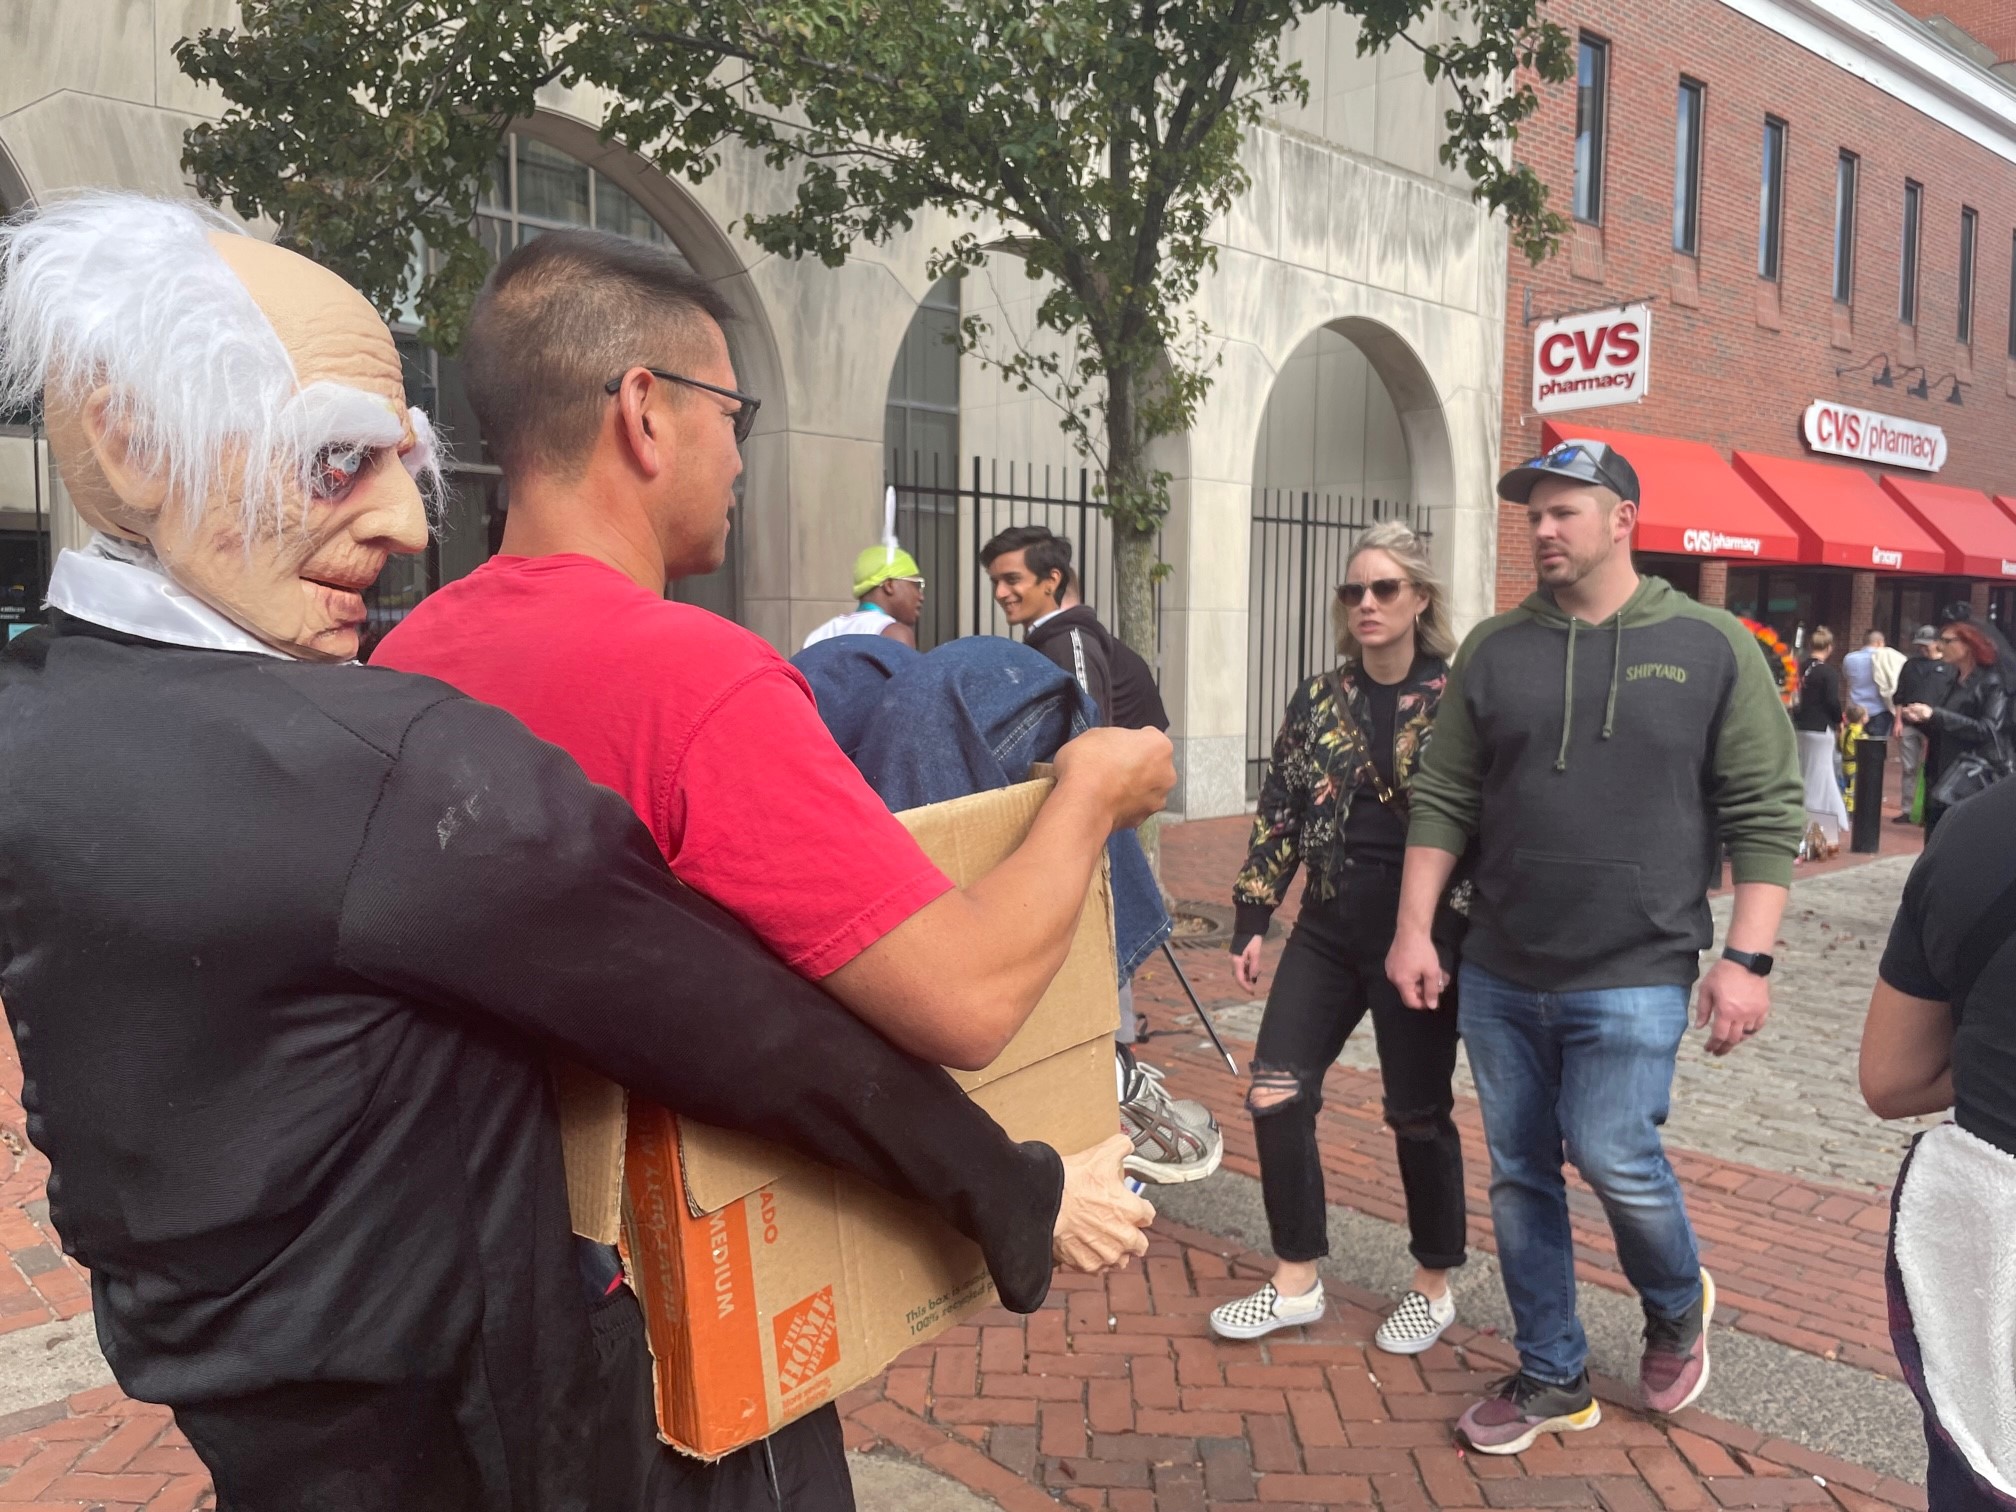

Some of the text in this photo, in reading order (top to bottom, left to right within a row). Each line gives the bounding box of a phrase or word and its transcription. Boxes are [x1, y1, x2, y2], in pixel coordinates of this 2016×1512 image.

[1539, 322, 1640, 376] CVS
[1538, 371, 1636, 400] pharmacy
[1625, 662, 1687, 684] SHIPYARD
[643, 1160, 668, 1231] DUTY
[708, 1209, 736, 1320] MEDIUM
[904, 1305, 928, 1325] This
[927, 1292, 950, 1311] box
[951, 1283, 962, 1297] is
[909, 1310, 940, 1336] 100%
[779, 1290, 834, 1389] HOME
[781, 1311, 806, 1349] THE
[803, 1314, 838, 1378] DEPOT
